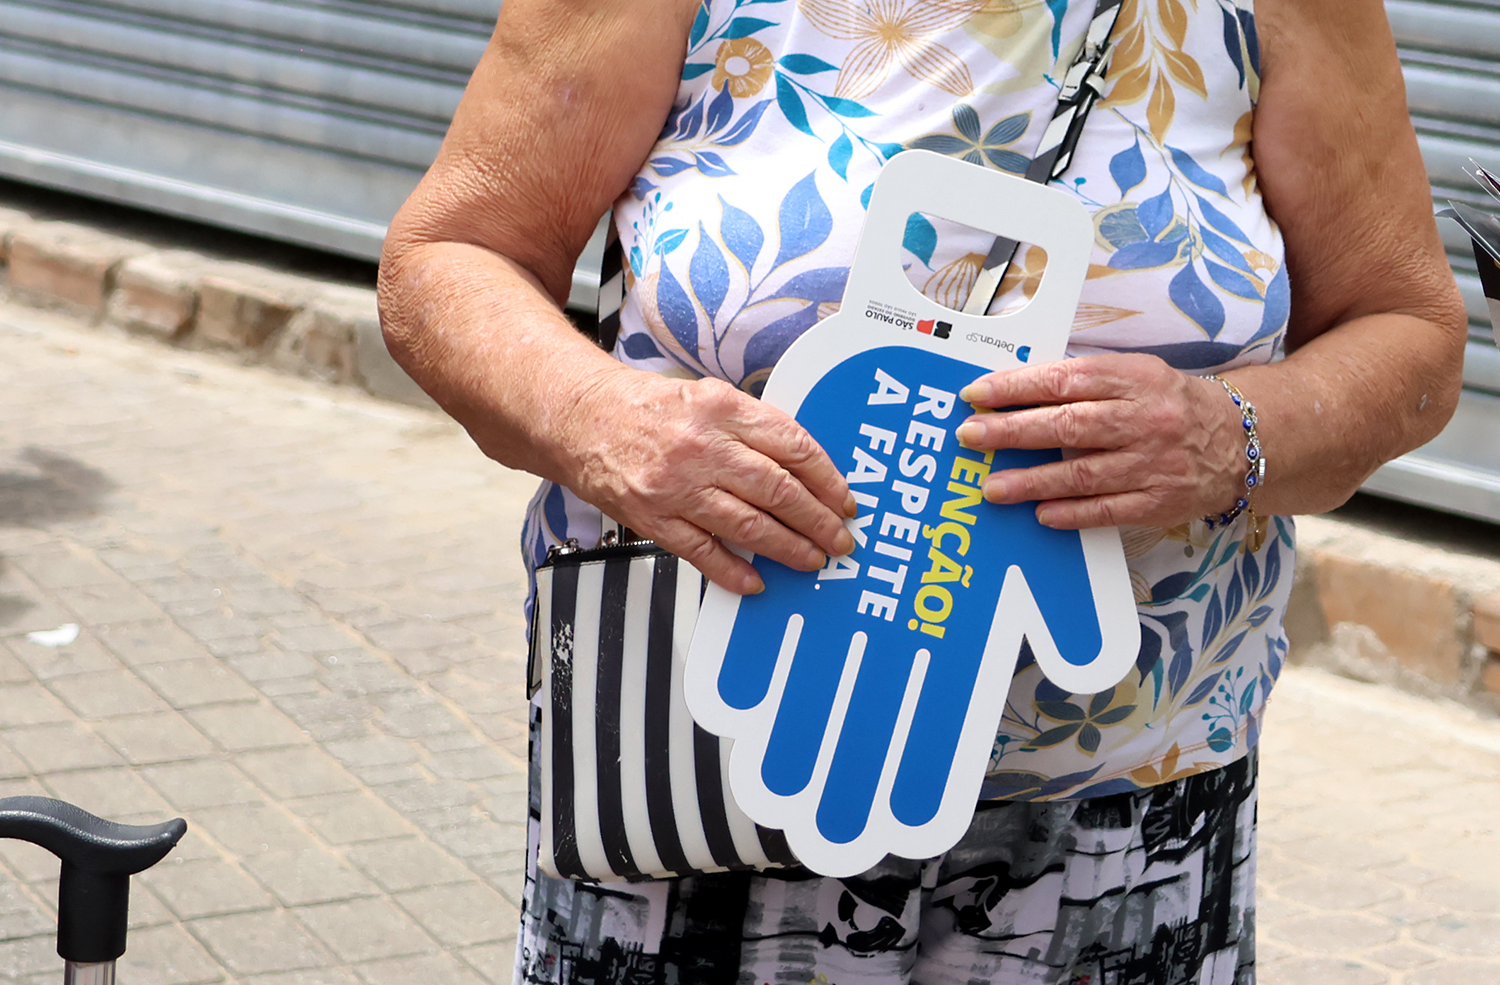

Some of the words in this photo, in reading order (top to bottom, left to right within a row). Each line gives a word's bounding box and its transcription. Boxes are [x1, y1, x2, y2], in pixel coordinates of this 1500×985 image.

[865, 310, 894, 324] PAULO
[895, 319, 915, 330] SÃO
[966, 332, 1015, 353] Detran.SP
[867, 368, 910, 405] A
[857, 384, 957, 622] RESPEITE
